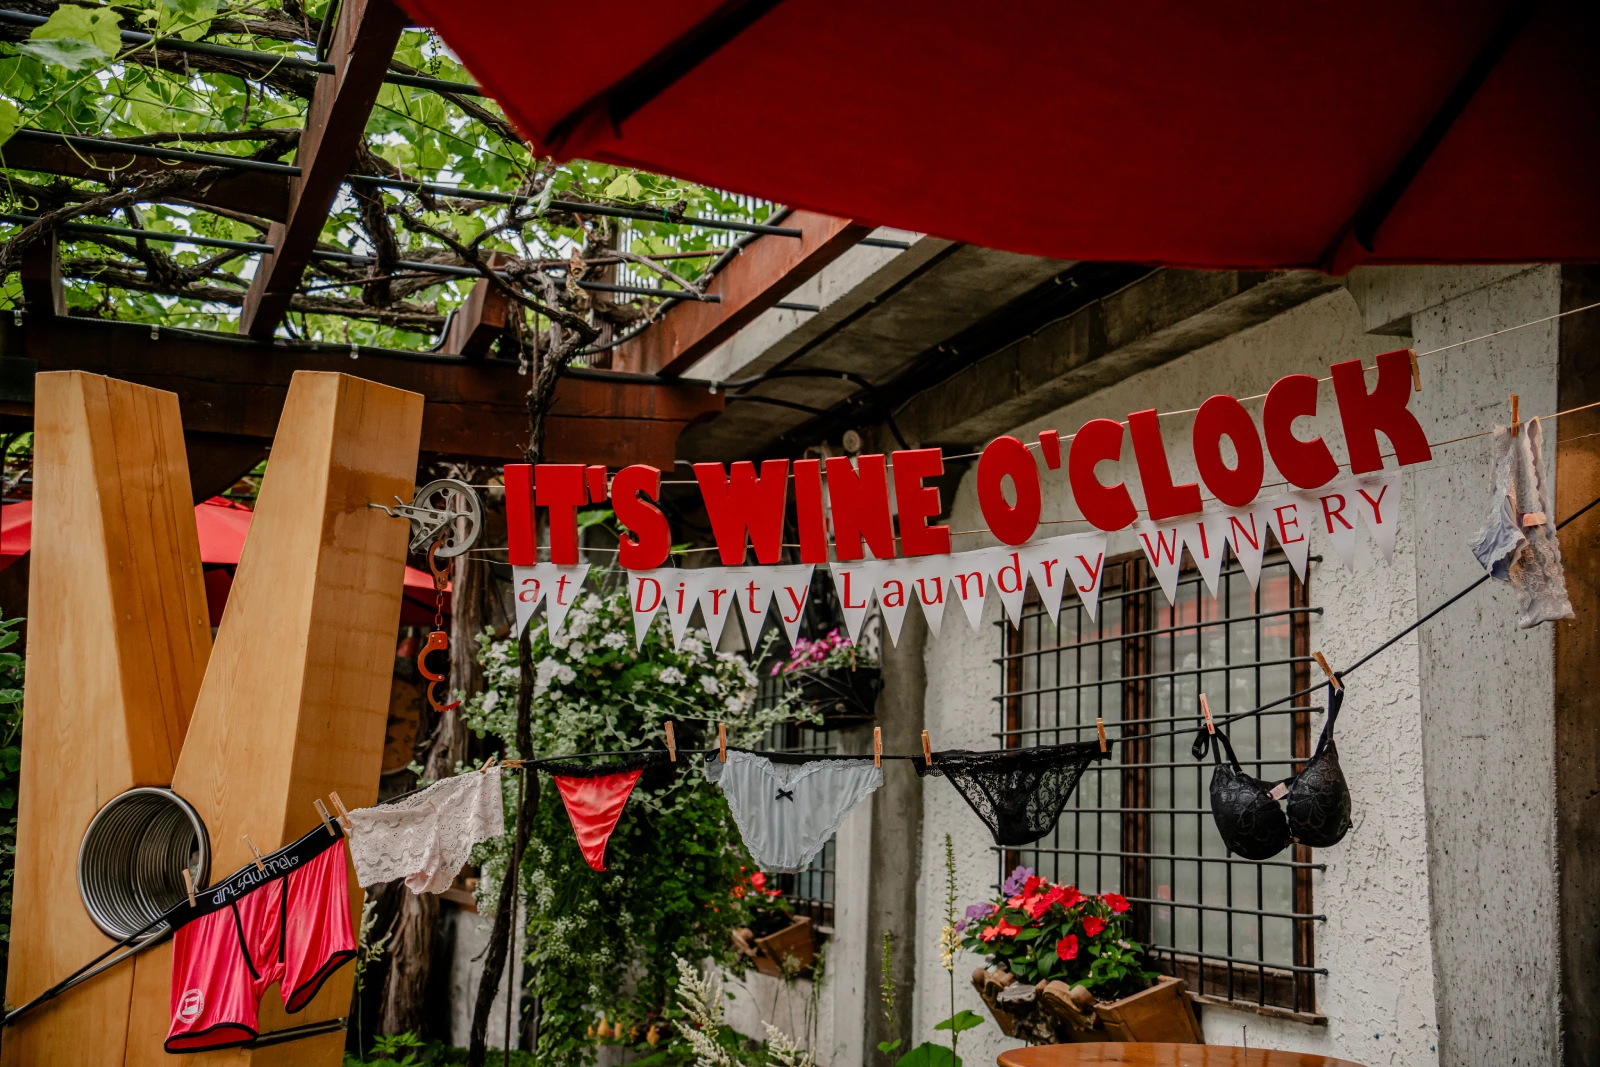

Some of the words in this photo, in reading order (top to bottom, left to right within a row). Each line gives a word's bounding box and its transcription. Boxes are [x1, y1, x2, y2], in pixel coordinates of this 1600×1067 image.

[504, 464, 671, 570] IT'S
[693, 447, 951, 565] WINE
[977, 349, 1433, 546] O'CLOCK
[518, 574, 572, 604] at
[634, 577, 809, 624] Dirty
[840, 552, 1103, 609] Laundry
[1139, 484, 1389, 570] WINERY
